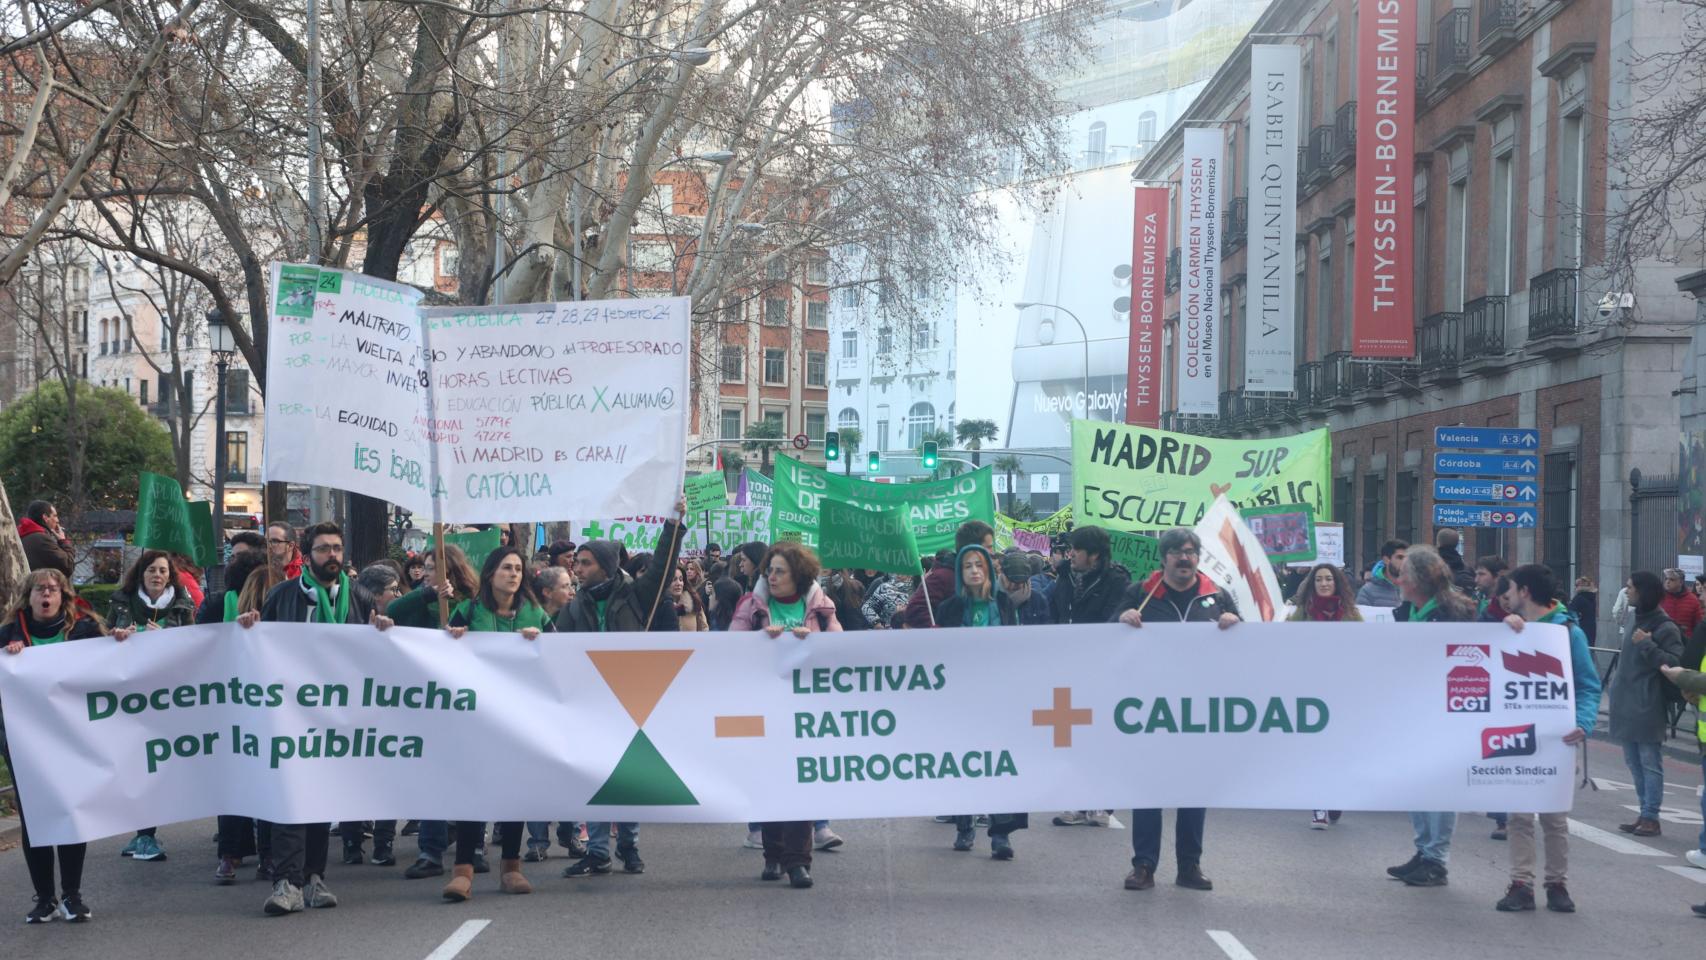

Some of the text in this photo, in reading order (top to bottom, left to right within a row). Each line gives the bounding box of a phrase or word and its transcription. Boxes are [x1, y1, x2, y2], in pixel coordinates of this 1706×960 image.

[1265, 73, 1285, 155] ISABEL
[1260, 163, 1283, 338] QUINTANILLA
[1187, 157, 1203, 378] COLECCIÓN CARMEN THYSSEN
[1203, 158, 1217, 378] en el Museo Nacional Thyssen-Bornemisza
[319, 275, 336, 289] 24
[1136, 212, 1157, 406] THYSSEN-BORNEMISZA
[356, 337, 402, 363] VUELTA
[469, 344, 555, 360] ABANDONO
[577, 340, 683, 356] PROFESORADO
[439, 372, 490, 389] HORAS
[500, 367, 572, 386] LECTIVAS
[531, 391, 586, 412] PÚBLICA
[612, 386, 674, 411] ALUMN@
[1034, 393, 1072, 413] Nuevo
[1075, 390, 1122, 414] Galaxy
[338, 409, 399, 438] EQUIDAD
[1440, 434, 1519, 443] Valencia A-3
[1090, 428, 1289, 479] MADRID SUR
[1439, 459, 1481, 467] Córdoba
[466, 472, 552, 501] CATÓLICA
[790, 465, 827, 489] IES
[1439, 486, 1471, 494] Toledo
[824, 541, 863, 558] SALUD
[792, 663, 947, 694] LECTIVAS
[1504, 681, 1568, 700] STEM
[87, 676, 477, 721] Docentes en lucha
[1449, 695, 1488, 711] CGT
[794, 709, 896, 739] RATIO
[1113, 696, 1331, 734] CALIDAD
[145, 725, 424, 773] por la pública
[1488, 733, 1528, 750] CNT
[796, 750, 1019, 783] BUROCRACIA
[1471, 765, 1557, 775] Sección Sindical
